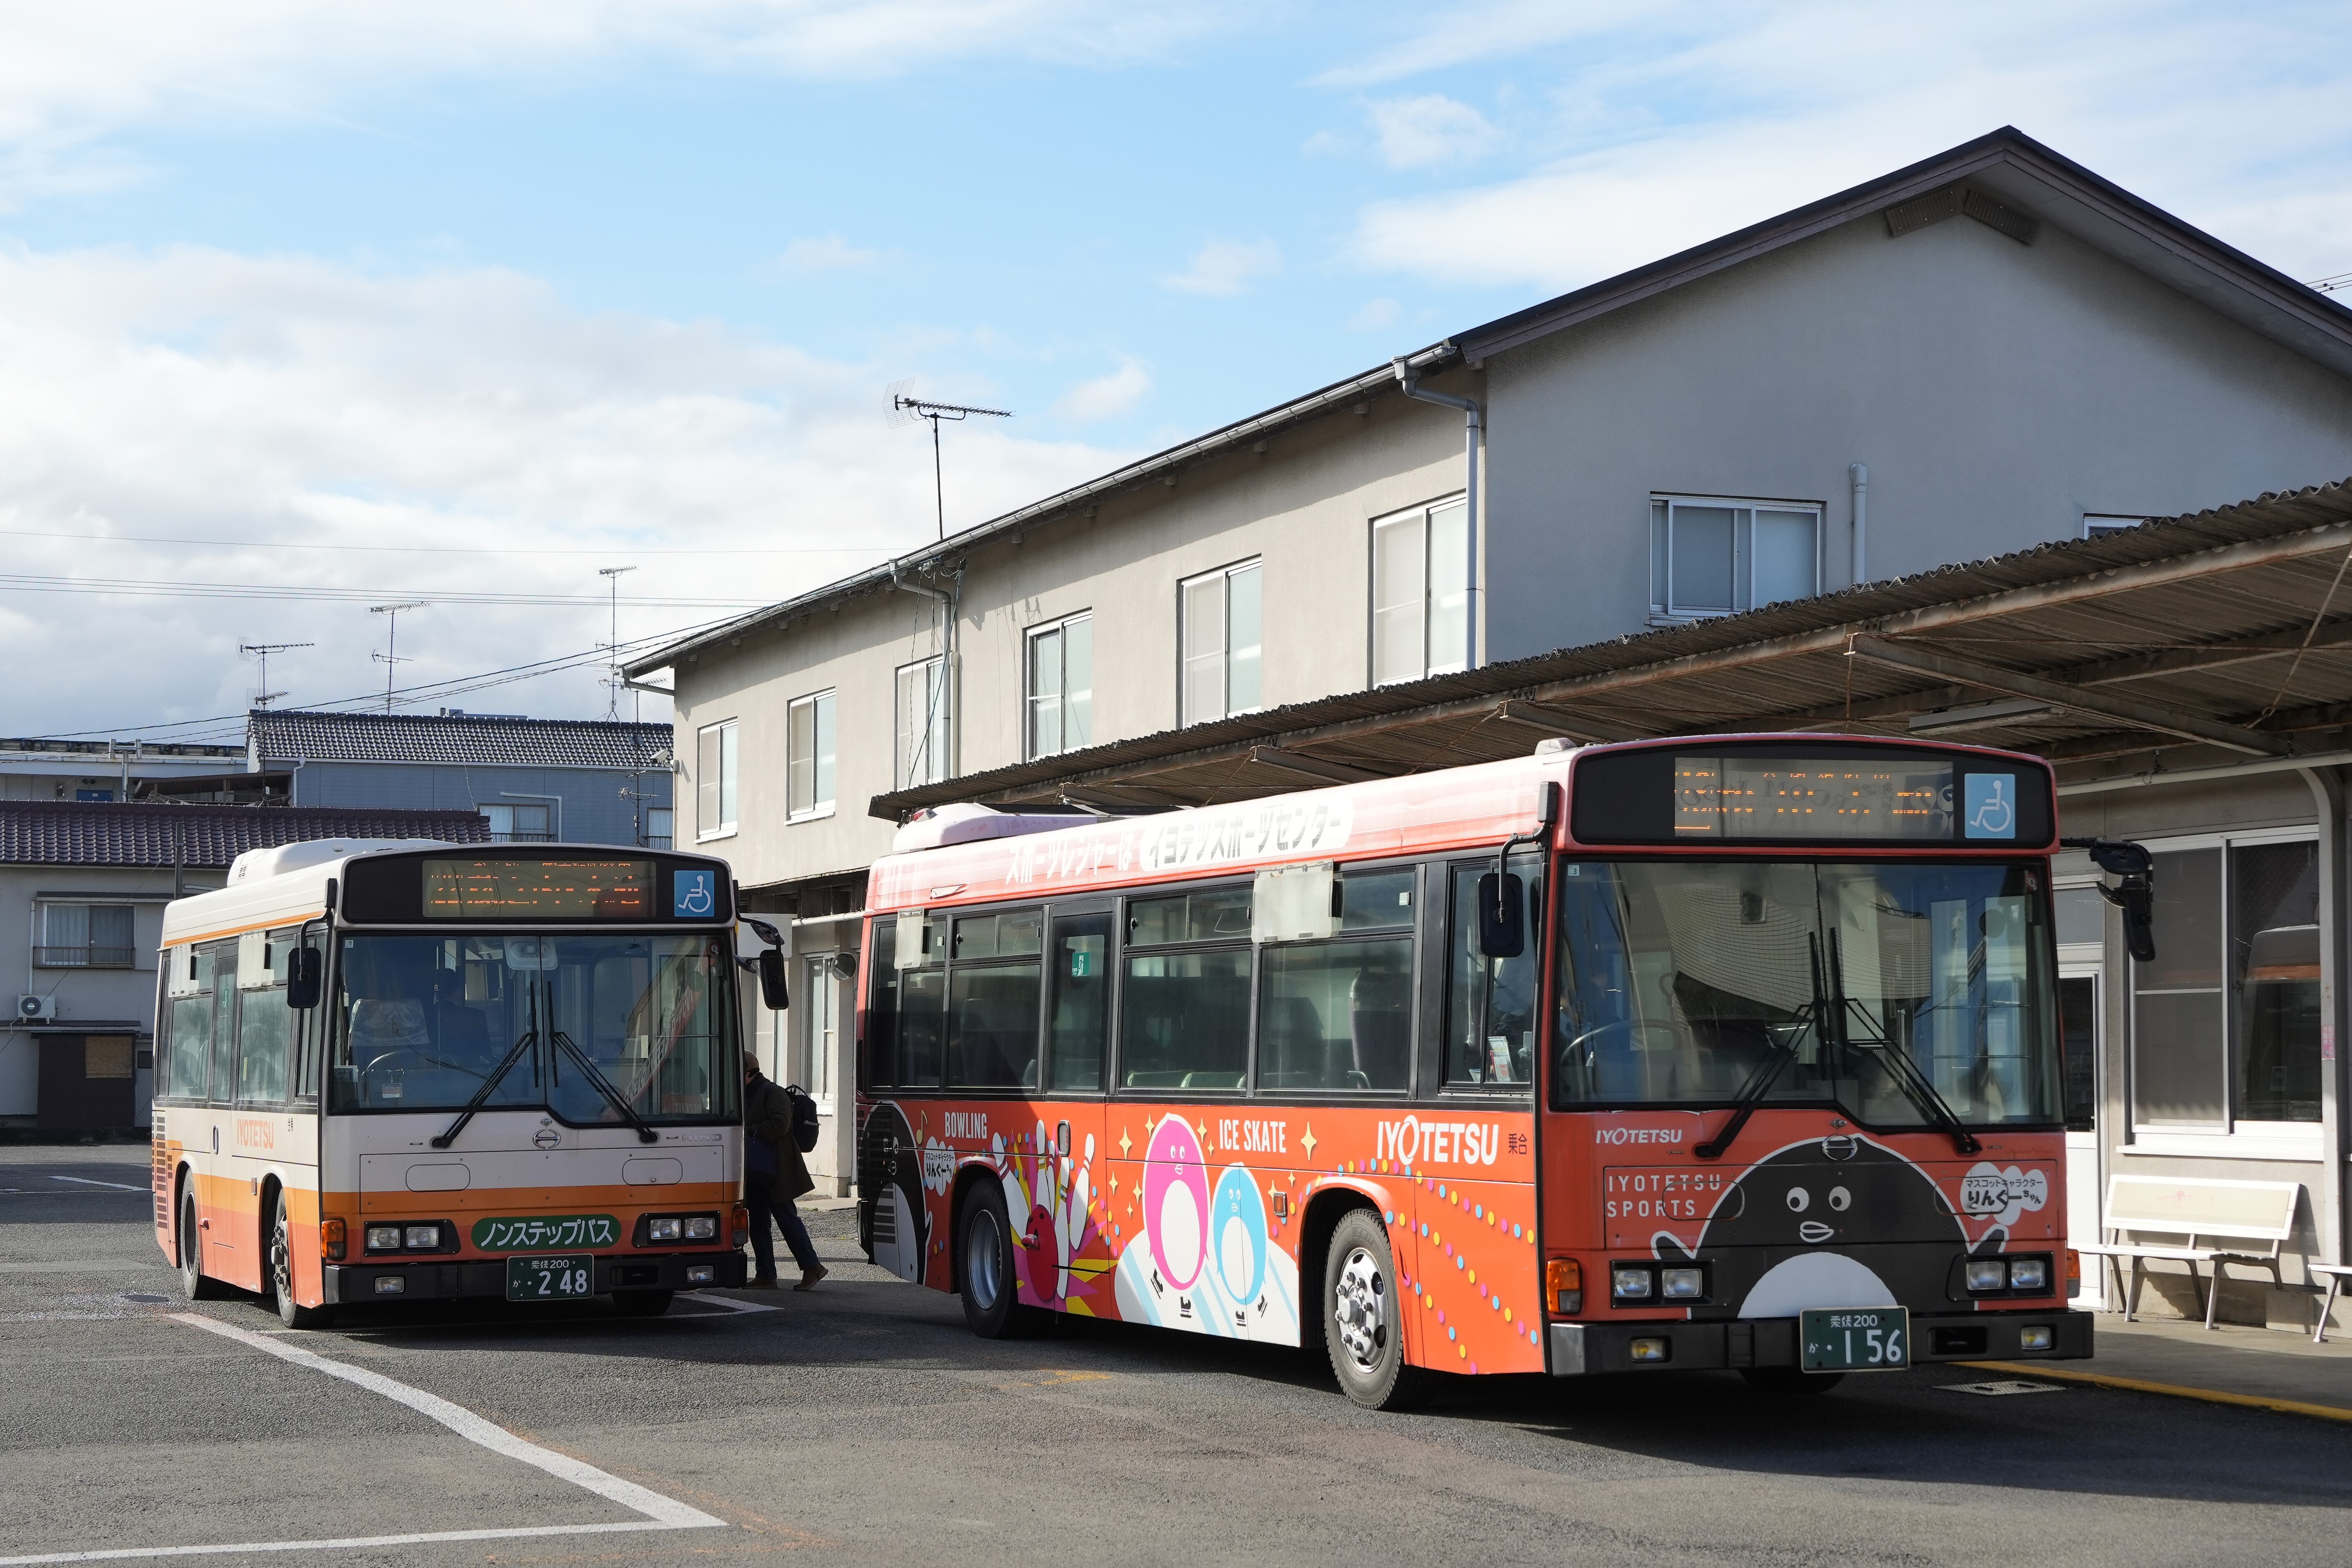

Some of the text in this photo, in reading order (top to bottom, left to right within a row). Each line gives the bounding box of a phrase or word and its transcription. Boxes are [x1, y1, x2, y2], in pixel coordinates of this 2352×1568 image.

[237, 1119, 274, 1149] IYOTETSU
[945, 1112, 987, 1139] BOWLING
[682, 1133, 722, 1142] HINO
[1219, 1119, 1286, 1153] ICE SKATE
[1377, 1115, 1499, 1165] IYOTETSU
[1508, 1133, 1527, 1155] 乗合
[1596, 1127, 1682, 1145] IYOTETSU
[1608, 1174, 1721, 1192] IYOTETSU
[1966, 1179, 2043, 1188] マスコットキャラクター
[1968, 1189, 2041, 1207] りんぐーちゃん
[1607, 1199, 1695, 1218] SPORTS
[481, 1219, 613, 1247] ノンステップバス
